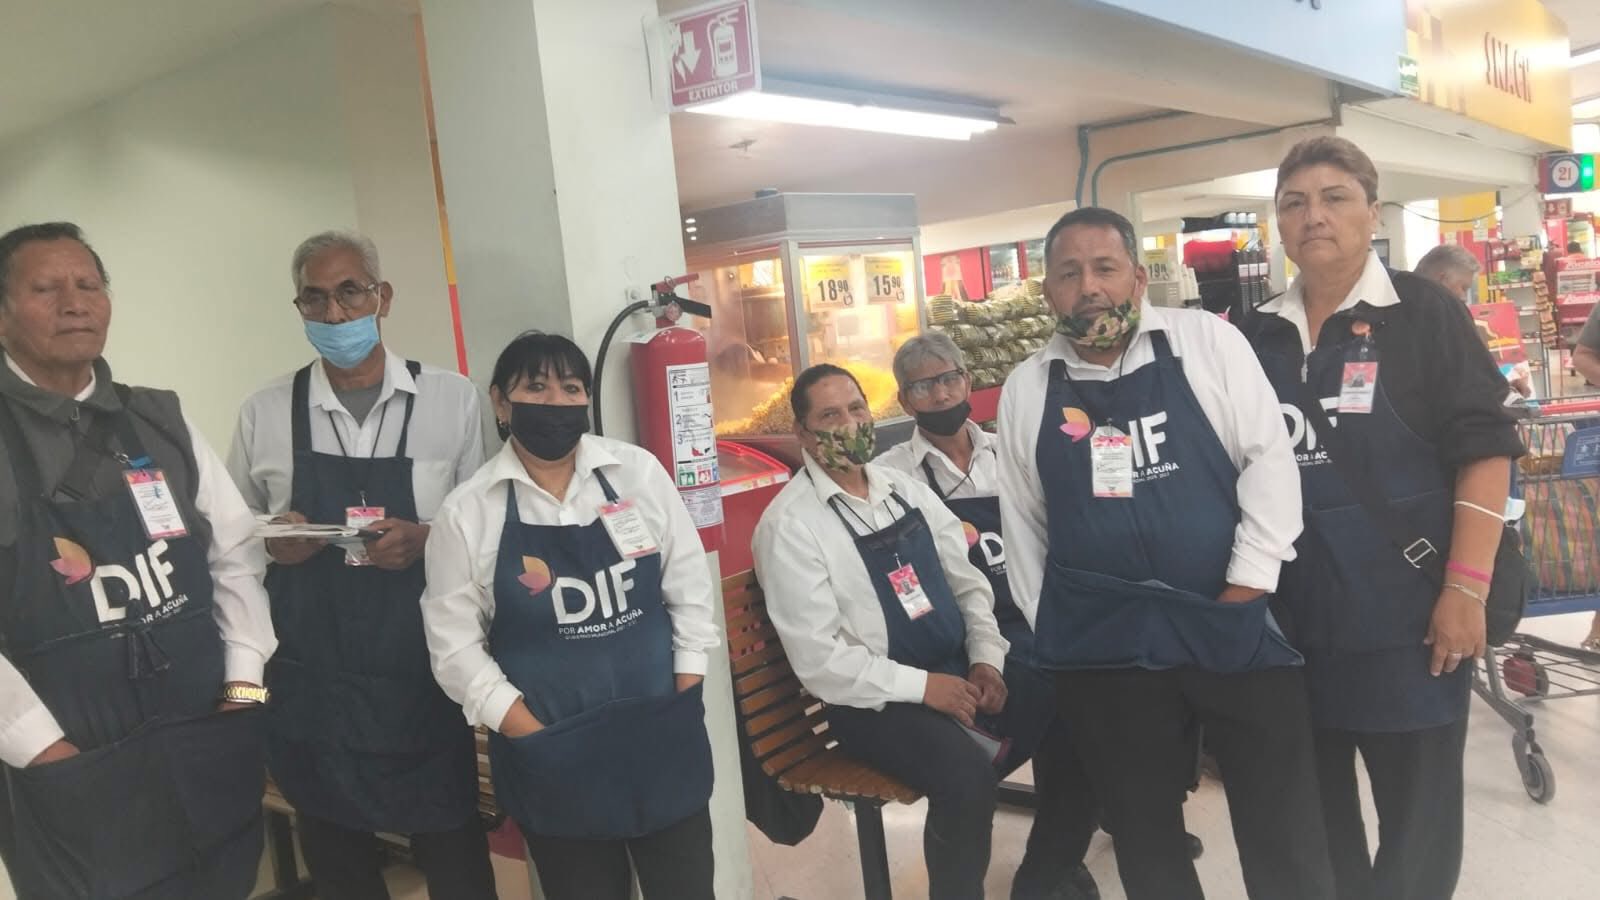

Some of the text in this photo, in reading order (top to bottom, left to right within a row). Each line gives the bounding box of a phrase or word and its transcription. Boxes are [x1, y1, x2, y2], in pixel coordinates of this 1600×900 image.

[689, 80, 738, 101] EXTINTOR
[1558, 167, 1572, 180] 21
[676, 414, 682, 425] 2
[1128, 410, 1167, 468] IF
[1296, 454, 1309, 462] OR
[1146, 462, 1180, 476] ACUÑA
[91, 538, 174, 622] DIF
[551, 558, 637, 625] DIF
[558, 627, 576, 635] POR
[577, 623, 608, 634] AMOR
[608, 621, 615, 629] A
[615, 608, 643, 626] ACUÑA
